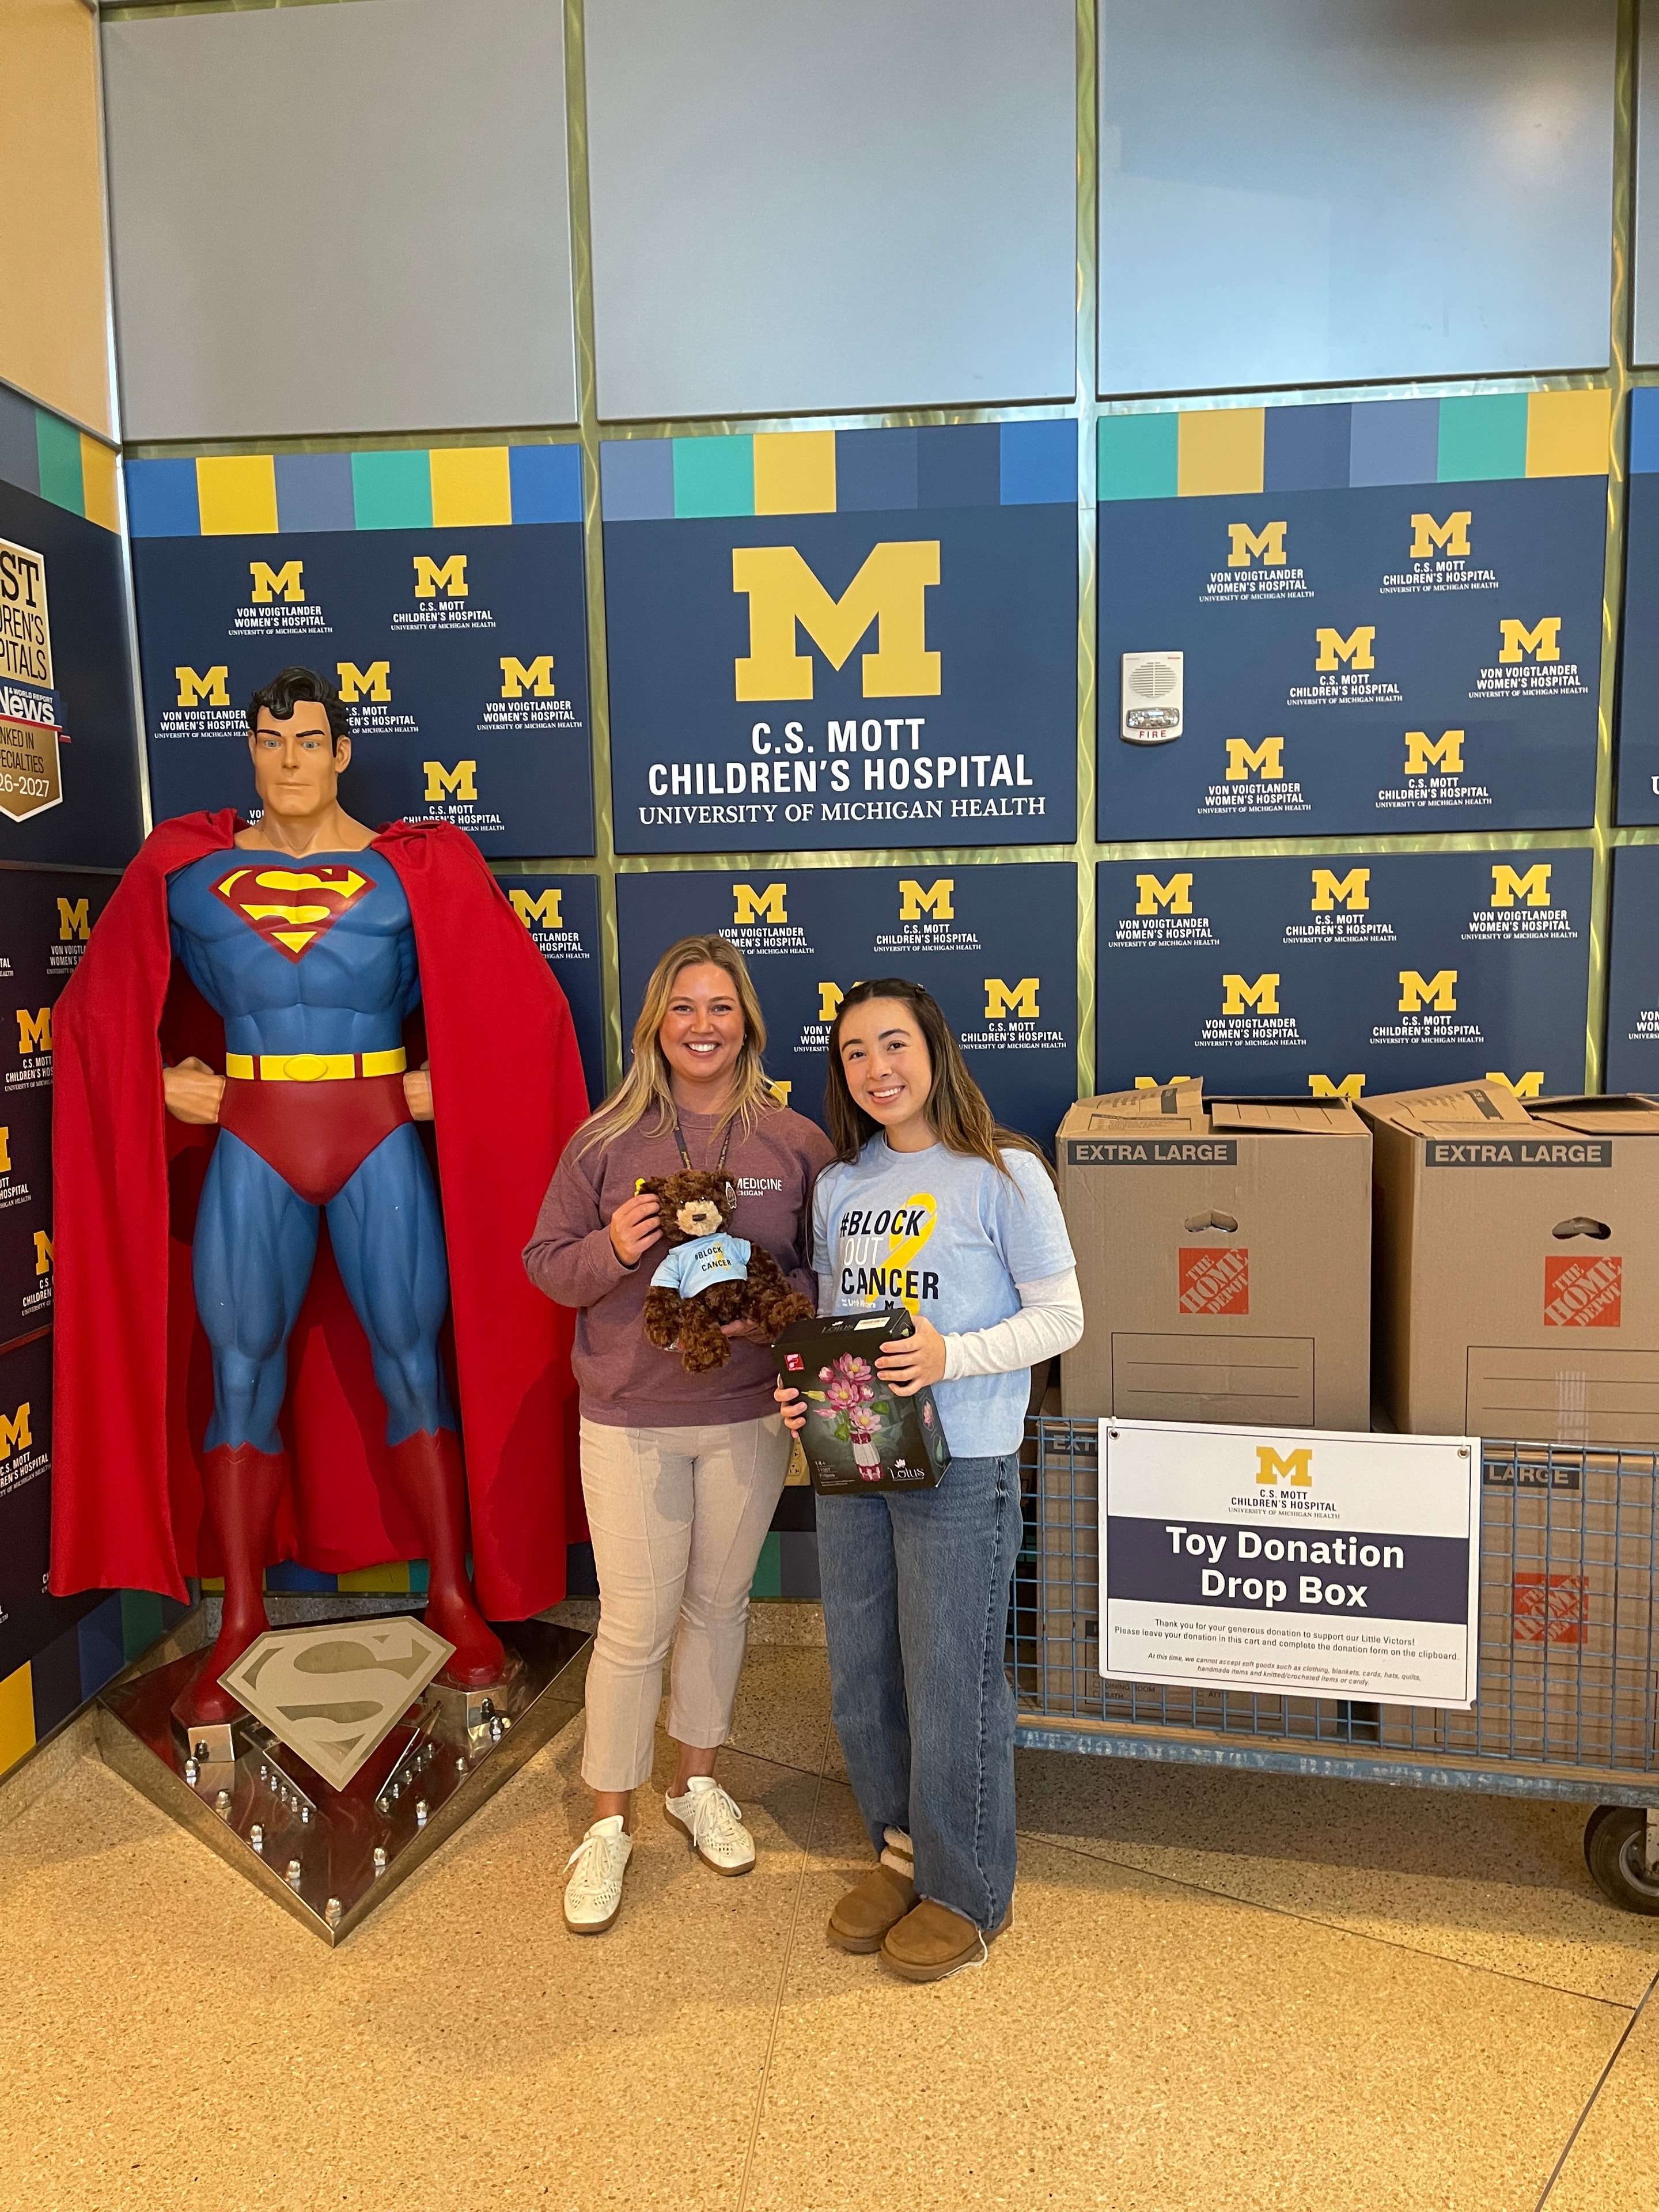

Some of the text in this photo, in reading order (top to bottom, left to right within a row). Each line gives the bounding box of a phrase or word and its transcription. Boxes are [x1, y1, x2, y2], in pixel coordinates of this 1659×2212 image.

[1410, 512, 1471, 558] M
[1, 551, 39, 608] ST
[1384, 570, 1495, 585] CHILDREN'S HOSPITAL
[1414, 560, 1465, 573] C.S. MOTT
[250, 561, 305, 603] M
[0, 603, 44, 646] REN'S
[234, 616, 325, 627] WOMEN'S HOSPITAL
[237, 606, 321, 617] VON VOIGTLANDER
[733, 541, 941, 702] M
[13, 688, 32, 699] WORLD
[33, 693, 53, 703] REPORT
[0, 727, 35, 749] NKED IN
[752, 718, 925, 755] C.S. MOTT
[1139, 730, 1166, 738] FIRE
[1, 749, 44, 773] ECIALTIES
[0, 774, 50, 797] 26-2027
[649, 754, 1033, 796] CHILDREN'S HOSPITAL
[639, 797, 1046, 824] UNIVERSITY OF MICHIGAN HEALTH
[899, 879, 954, 920] M
[1136, 873, 1193, 915] M
[904, 924, 950, 934] C.S. MOTT
[1116, 928, 1213, 940] WOMEN'S HOSPITAL
[1119, 918, 1209, 929] VON VOIGTLANDER
[877, 933, 978, 944] CHILDREN'S HOSPITAL
[1399, 971, 1457, 1012] M
[1373, 1025, 1480, 1036] CHILDREN'S HOSPITAL
[1403, 1016, 1452, 1025] C.S. MOTT
[1076, 1145, 1228, 1161] EXTRA LARGE
[1435, 1145, 1601, 1162] EXTRA LARGE
[840, 1210, 926, 1237] #BLOCK
[695, 1247, 722, 1260] #BLOCK
[844, 1237, 884, 1266] OUT
[702, 1259, 732, 1271] CANCER
[1185, 1255, 1214, 1281] THE
[1552, 1263, 1584, 1291] THE
[842, 1268, 939, 1300] CANCER
[1180, 1249, 1248, 1313] HOME
[1206, 1273, 1248, 1313] DEPOT
[1544, 1256, 1621, 1325] HOME
[1574, 1283, 1621, 1325] DEPOT
[1256, 1446, 1312, 1487] M
[1231, 1498, 1336, 1512] CHILDREN'S HOSPITAL
[1260, 1490, 1308, 1499] C.S. MOTT
[1228, 1507, 1266, 1515] UNIVERSITY
[1166, 1526, 1404, 1568] Toy Donation
[1202, 1569, 1368, 1607] Drop Box
[1115, 1626, 1139, 1635] Please
[1142, 1628, 1162, 1637] leave
[1183, 1632, 1216, 1641] donation
[1228, 1635, 1241, 1643] this
[1279, 1641, 1315, 1649] complete
[1318, 1642, 1330, 1650] the
[1333, 1643, 1367, 1653] donation
[1370, 1646, 1388, 1654] form
[1403, 1649, 1415, 1657] the
[1418, 1650, 1459, 1660] clipboard.
[1155, 1619, 1177, 1627] Thank
[1180, 1622, 1194, 1630] you
[1196, 1622, 1206, 1630] for
[1228, 1626, 1264, 1635] generous
[1267, 1628, 1301, 1637] donation
[1313, 1633, 1343, 1641] support
[1362, 1634, 1380, 1643] Little
[1383, 1636, 1414, 1646] Victors!
[1197, 1665, 1230, 1673] handmade
[1263, 1671, 1320, 1681] knitted/crocheted
[1332, 1668, 1360, 1676] blankets,
